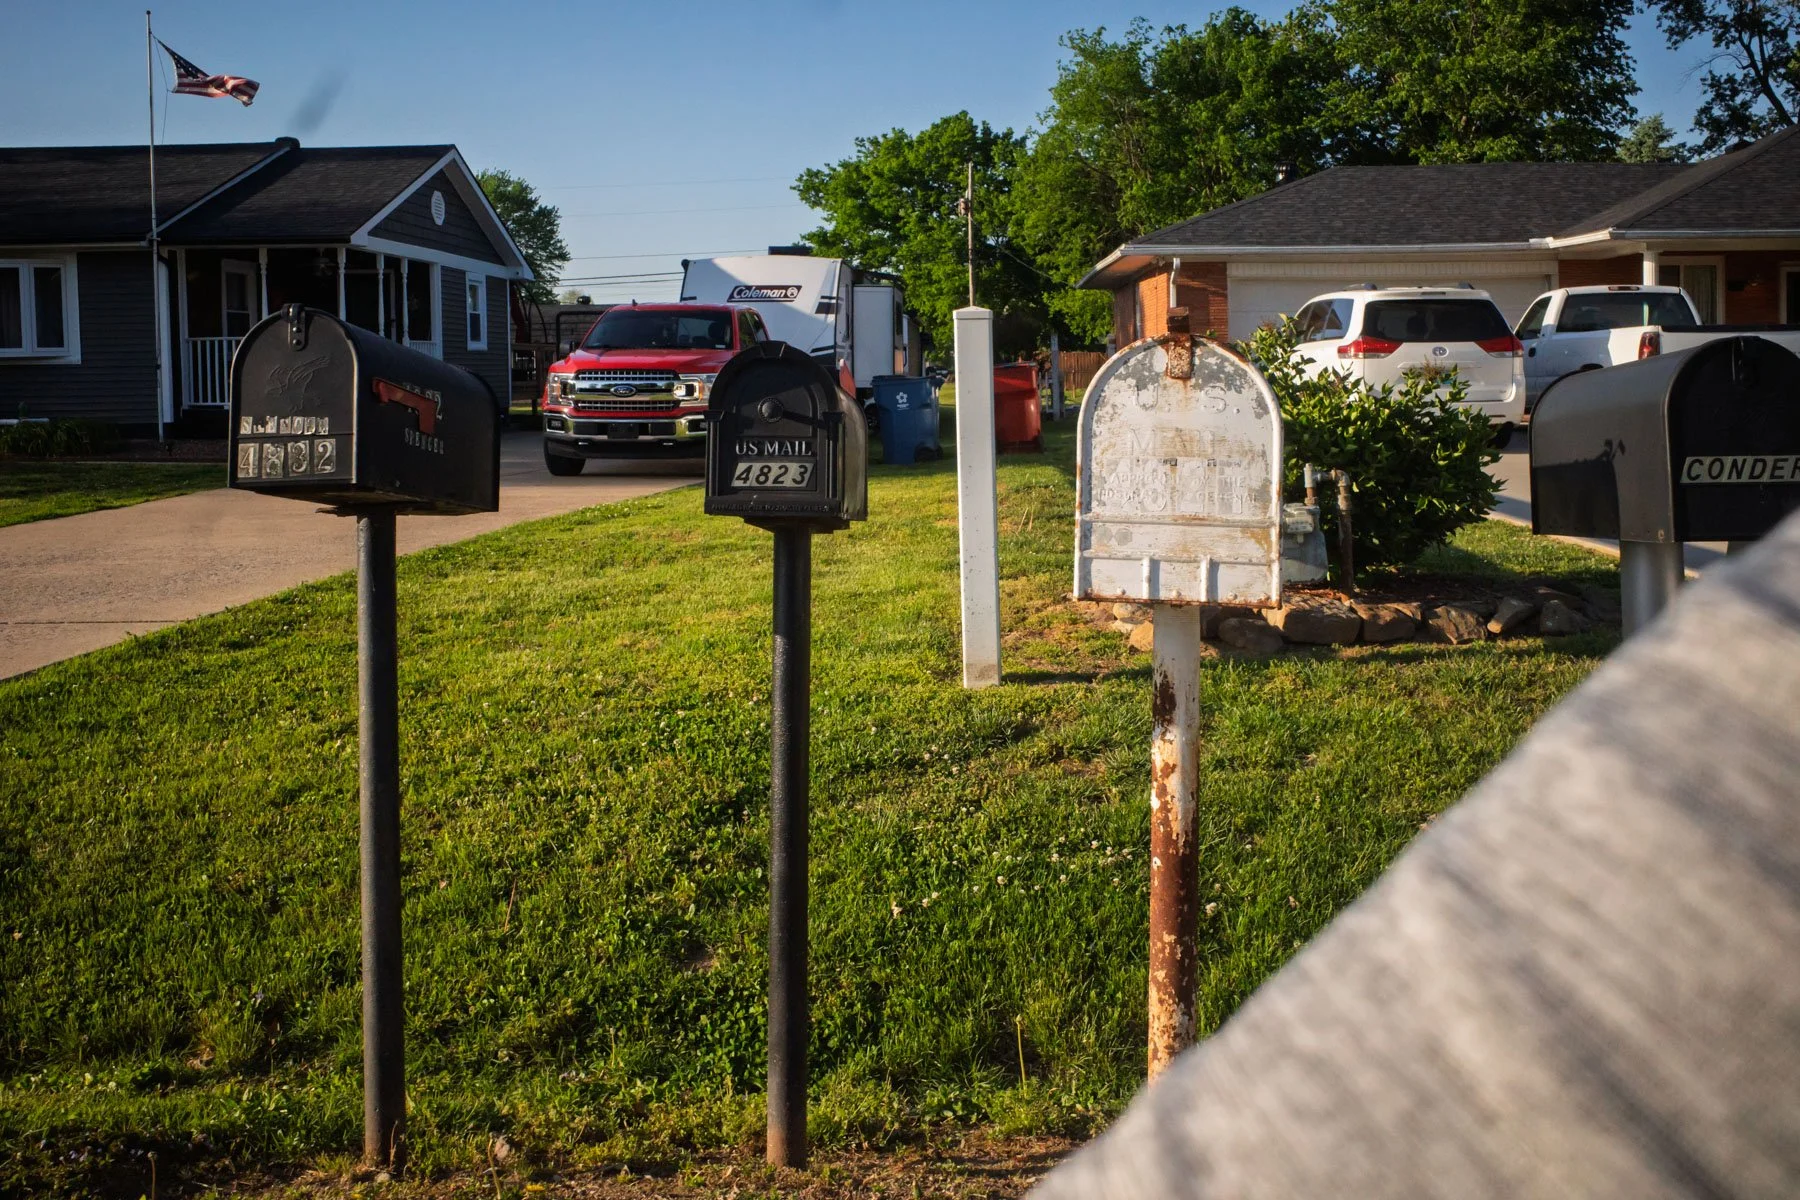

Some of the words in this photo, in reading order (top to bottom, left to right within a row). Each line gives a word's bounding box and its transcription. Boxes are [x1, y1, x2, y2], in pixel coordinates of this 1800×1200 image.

[733, 286, 786, 299] Coleman
[735, 440, 758, 456] US
[764, 440, 812, 456] MAIL
[239, 440, 334, 477] 4832
[735, 464, 809, 485] 4823
